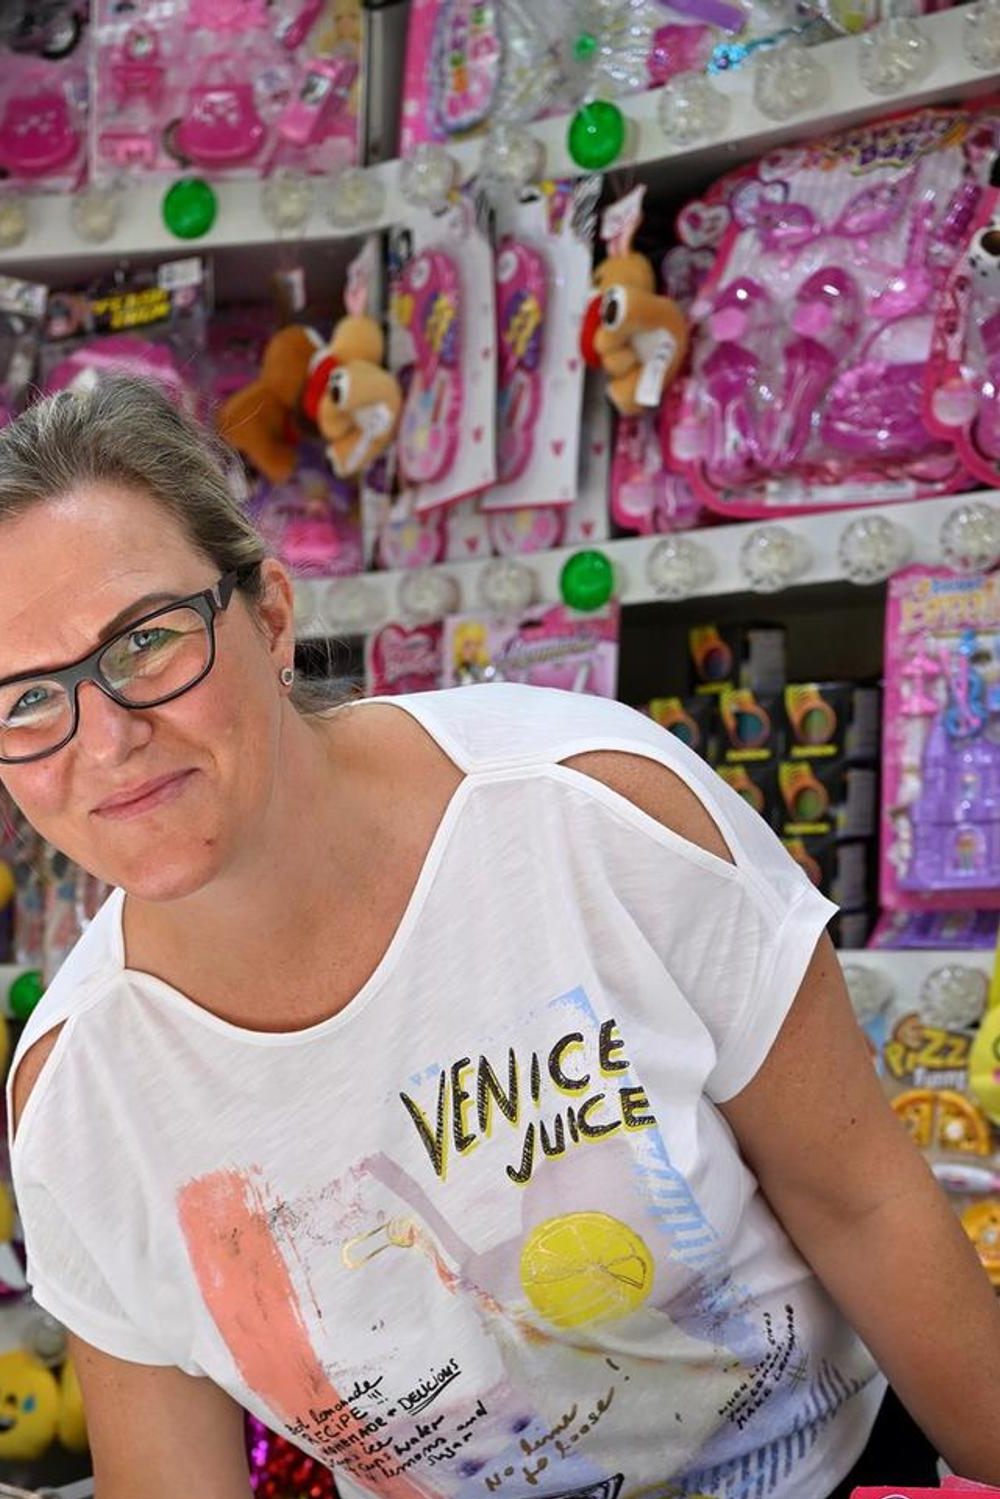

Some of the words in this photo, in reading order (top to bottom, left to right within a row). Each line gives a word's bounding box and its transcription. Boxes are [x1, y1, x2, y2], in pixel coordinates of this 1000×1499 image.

[399, 1018, 631, 1178] VENICE
[506, 1086, 658, 1184] JUICE
[456, 1399, 488, 1432] and
[736, 1386, 773, 1431] MAKE
[485, 1465, 515, 1493] No
